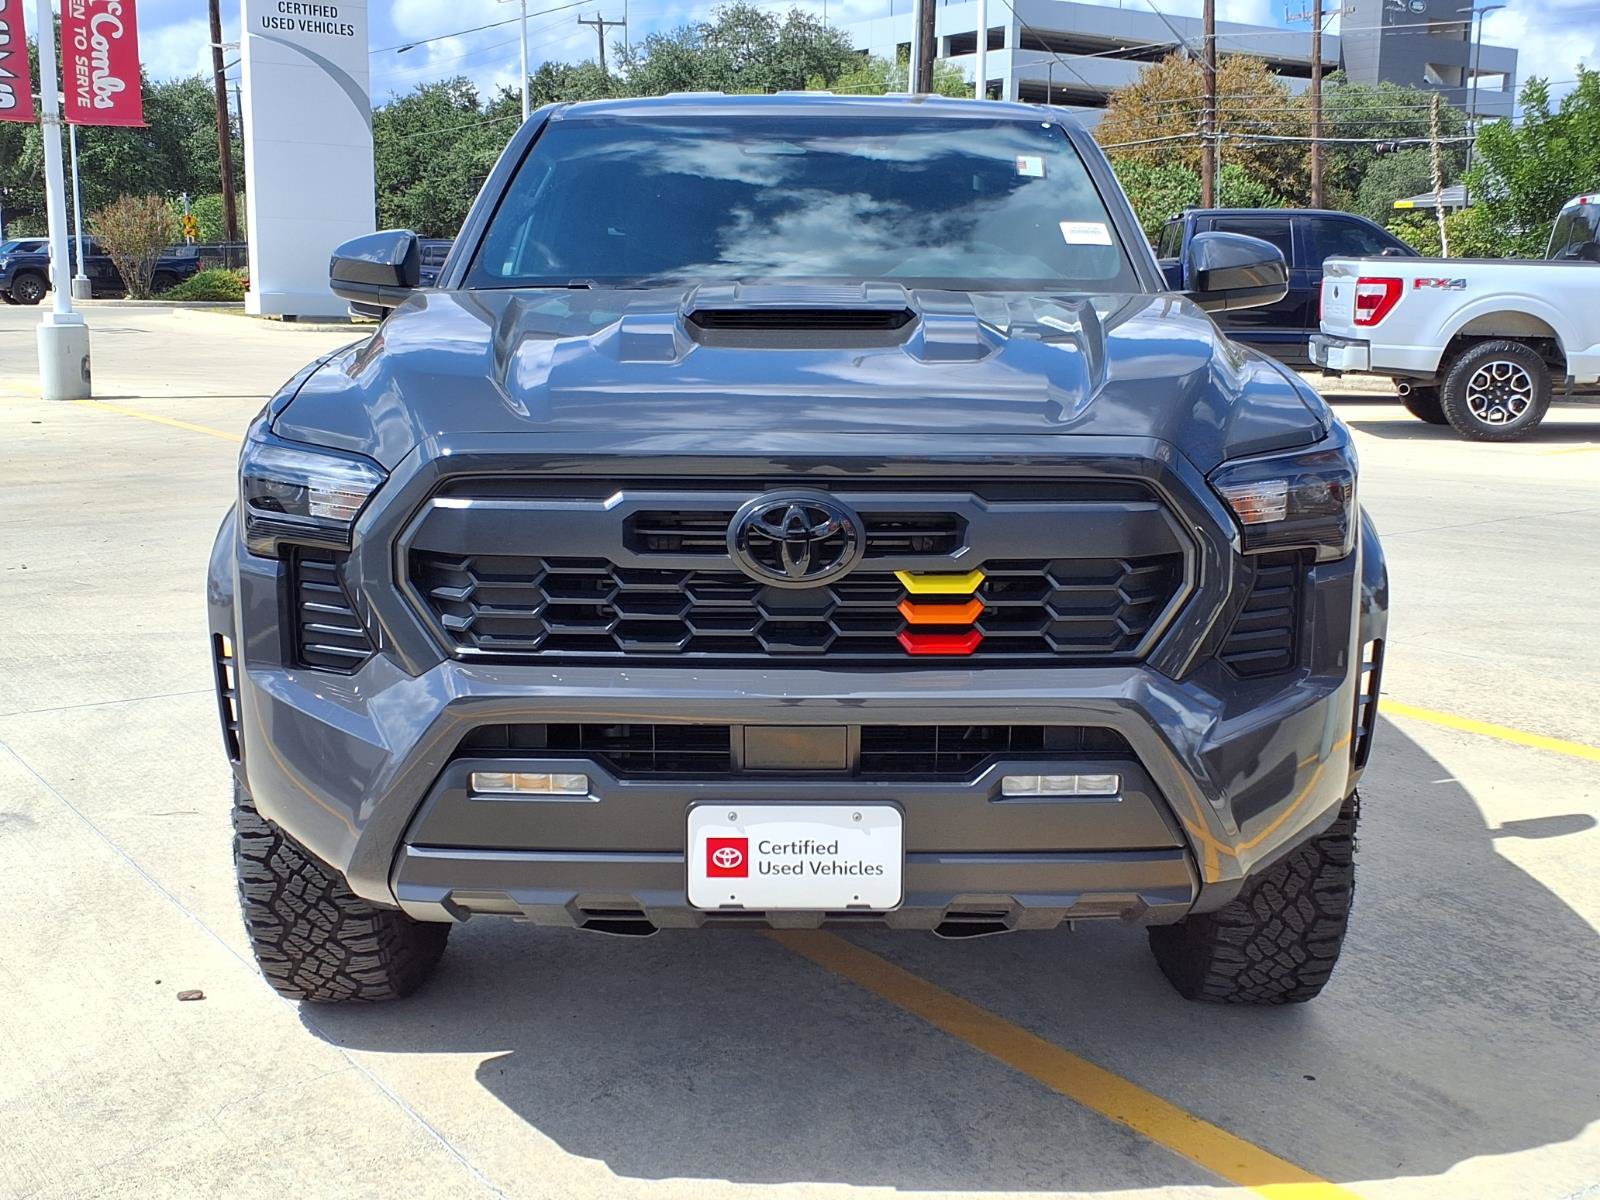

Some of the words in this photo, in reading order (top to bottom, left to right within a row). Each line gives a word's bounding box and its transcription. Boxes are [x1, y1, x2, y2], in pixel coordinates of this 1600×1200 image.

[278, 1, 338, 19] CERTIFIED
[262, 15, 295, 31] USED
[298, 20, 355, 37] VEHICLES
[73, 26, 88, 50] TO
[89, 0, 125, 108] cCombs
[74, 55, 91, 108] SERVE
[1413, 277, 1467, 290] FX4
[758, 840, 839, 855] Certified
[758, 860, 804, 876] Used
[809, 860, 884, 876] Vehicles
